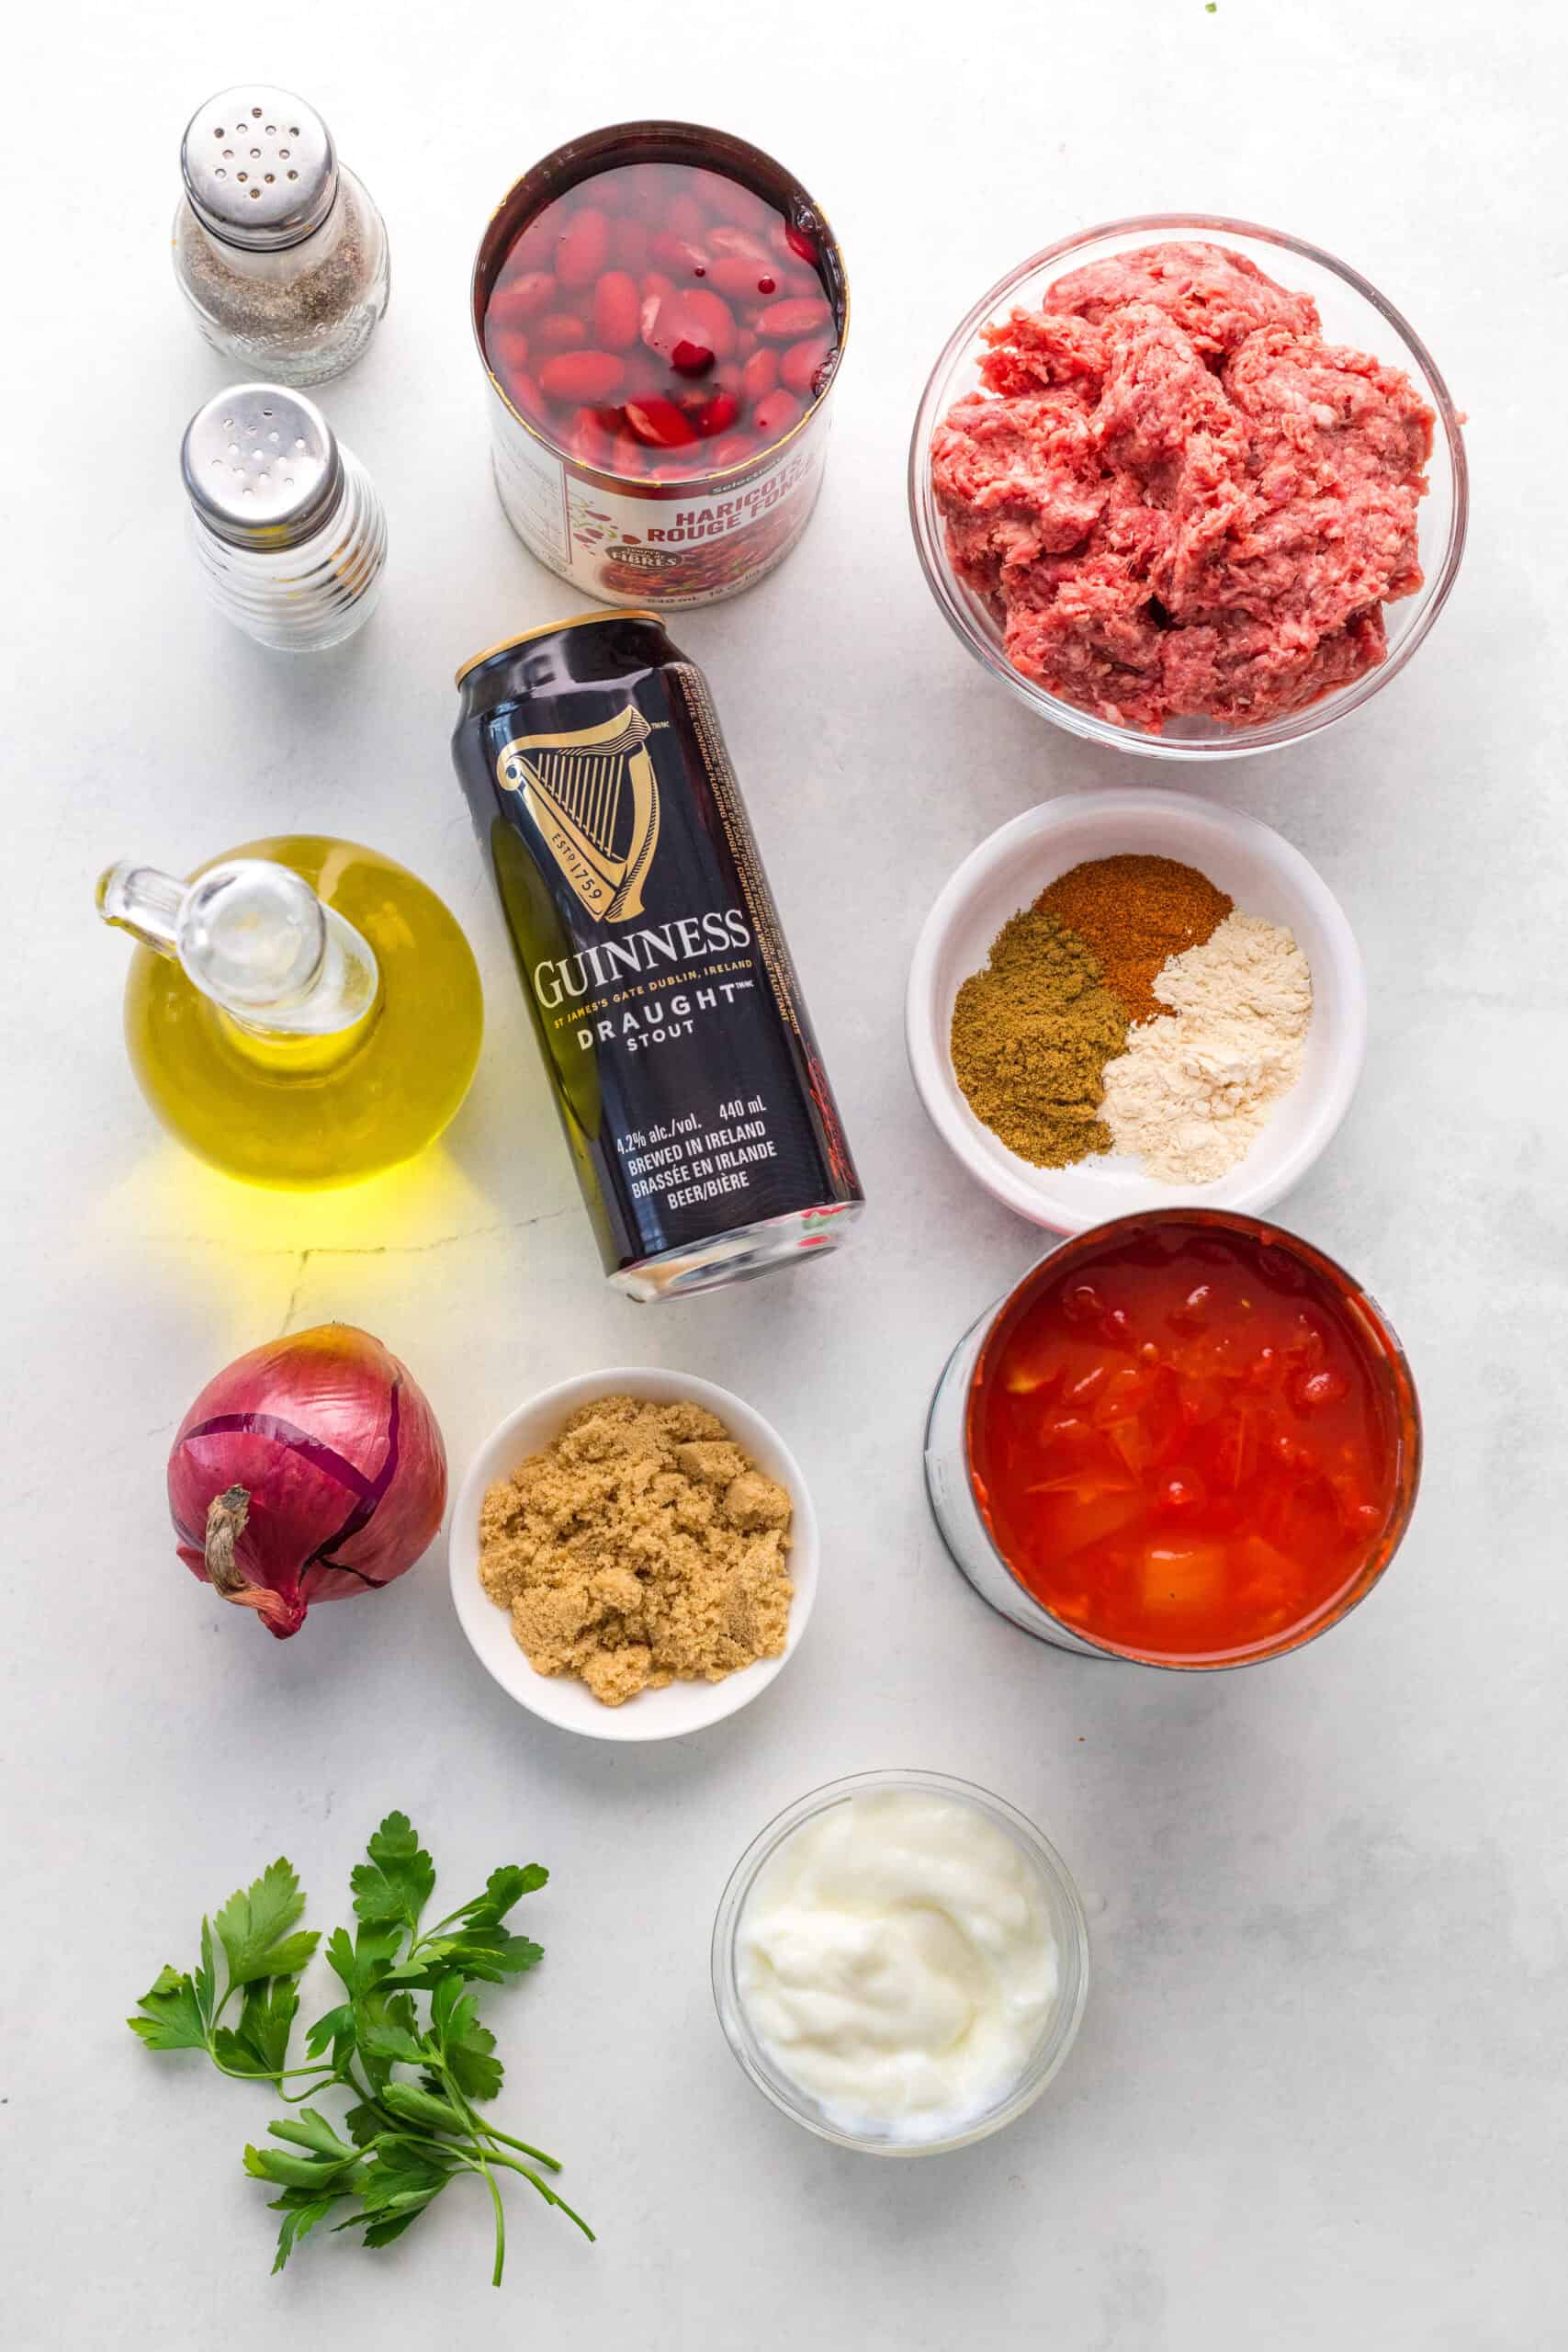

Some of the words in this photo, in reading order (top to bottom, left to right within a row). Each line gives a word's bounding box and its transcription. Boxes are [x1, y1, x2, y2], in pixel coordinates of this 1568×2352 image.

[648, 513, 741, 542] ROUGE
[612, 551, 677, 567] FIBRES
[570, 862, 603, 899] 1759
[692, 720, 713, 772] CONTAINS
[707, 771, 728, 818] FLOATING
[723, 820, 739, 857] WIDGET
[737, 865, 757, 914] CONTIENT
[751, 915, 762, 932] UN
[757, 931, 774, 971] WIDGET
[769, 971, 790, 1022] FLOTTANT
[534, 909, 750, 1009] GUINNESS
[554, 1016, 565, 1029] ST
[567, 998, 608, 1023] JAMES'S
[612, 986, 645, 1003] GATE
[704, 959, 753, 977] IRELAND
[577, 982, 735, 1051] DRAUGHT
[626, 1020, 694, 1052] STOUT
[615, 1131, 647, 1155] 4.2%
[649, 1113, 703, 1145] alc./vol.
[718, 1100, 745, 1121] 440
[748, 1094, 767, 1114] mL
[627, 1145, 683, 1177] BREWED
[686, 1136, 704, 1157] IN
[705, 1120, 767, 1151] IRELAND
[631, 1161, 692, 1199] BRASSÉE
[694, 1158, 714, 1178] EN
[716, 1140, 778, 1171] IRLANDE
[666, 1170, 750, 1210] BEER/BIÈRE
